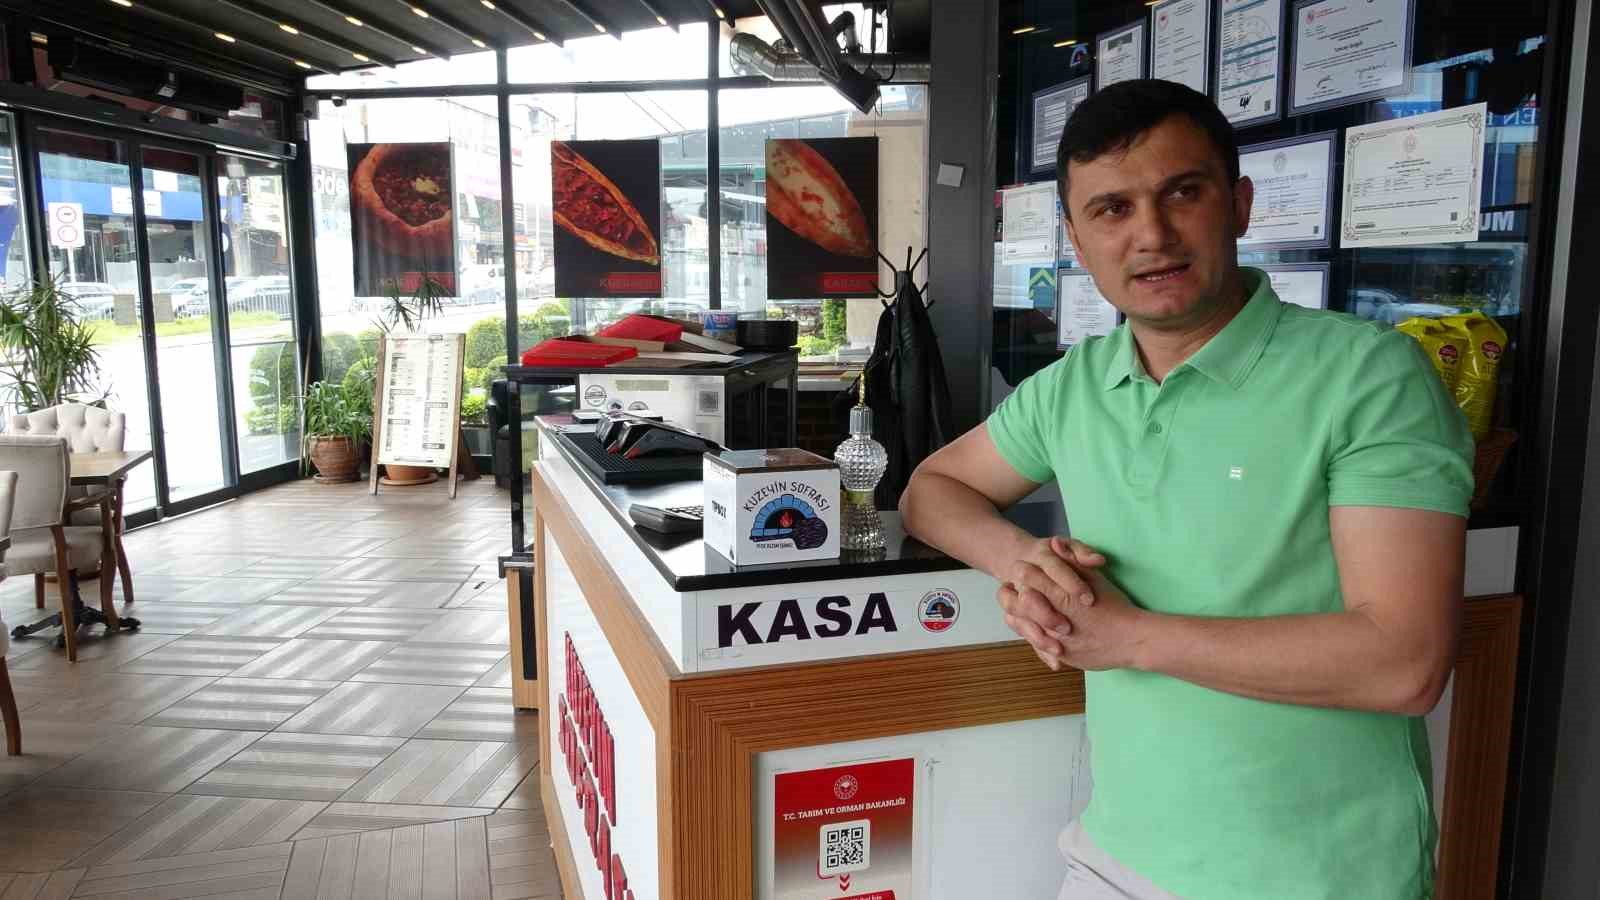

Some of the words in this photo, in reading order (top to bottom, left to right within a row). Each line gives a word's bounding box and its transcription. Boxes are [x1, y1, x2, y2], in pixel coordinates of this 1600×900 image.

[791, 481, 830, 512] SOFRASI
[717, 592, 898, 648] KASA
[783, 812, 797, 820] T.C.
[798, 808, 823, 819] TARIM
[825, 807, 835, 815] VE
[836, 803, 865, 813] ORMAN
[865, 796, 906, 809] BAKANLIĞI
